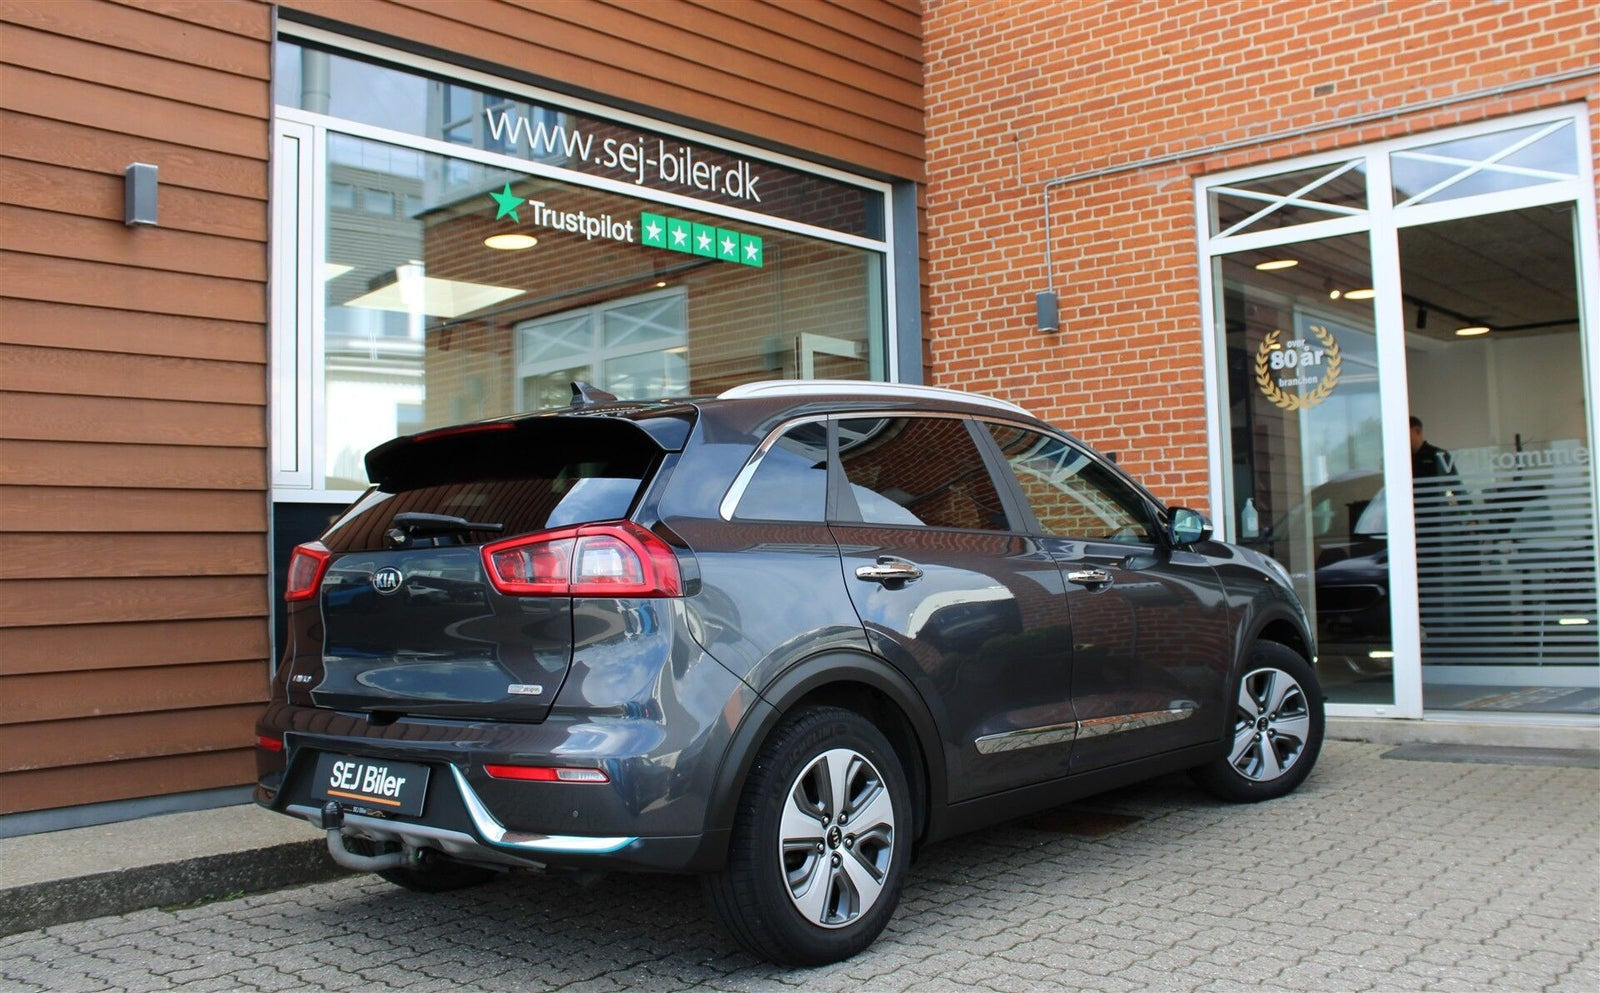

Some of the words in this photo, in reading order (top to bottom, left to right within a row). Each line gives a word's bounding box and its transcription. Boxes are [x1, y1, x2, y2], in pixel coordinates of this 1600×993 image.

[486, 108, 761, 203] www.sej-biler.dk
[529, 200, 634, 243] Trustpilot
[1286, 339, 1306, 348] over
[1270, 349, 1298, 370] 80
[1300, 345, 1324, 367] år
[1278, 375, 1318, 388] branchen
[376, 572, 397, 588] KIA
[330, 760, 363, 790] SEJ
[362, 765, 406, 798] Biler
